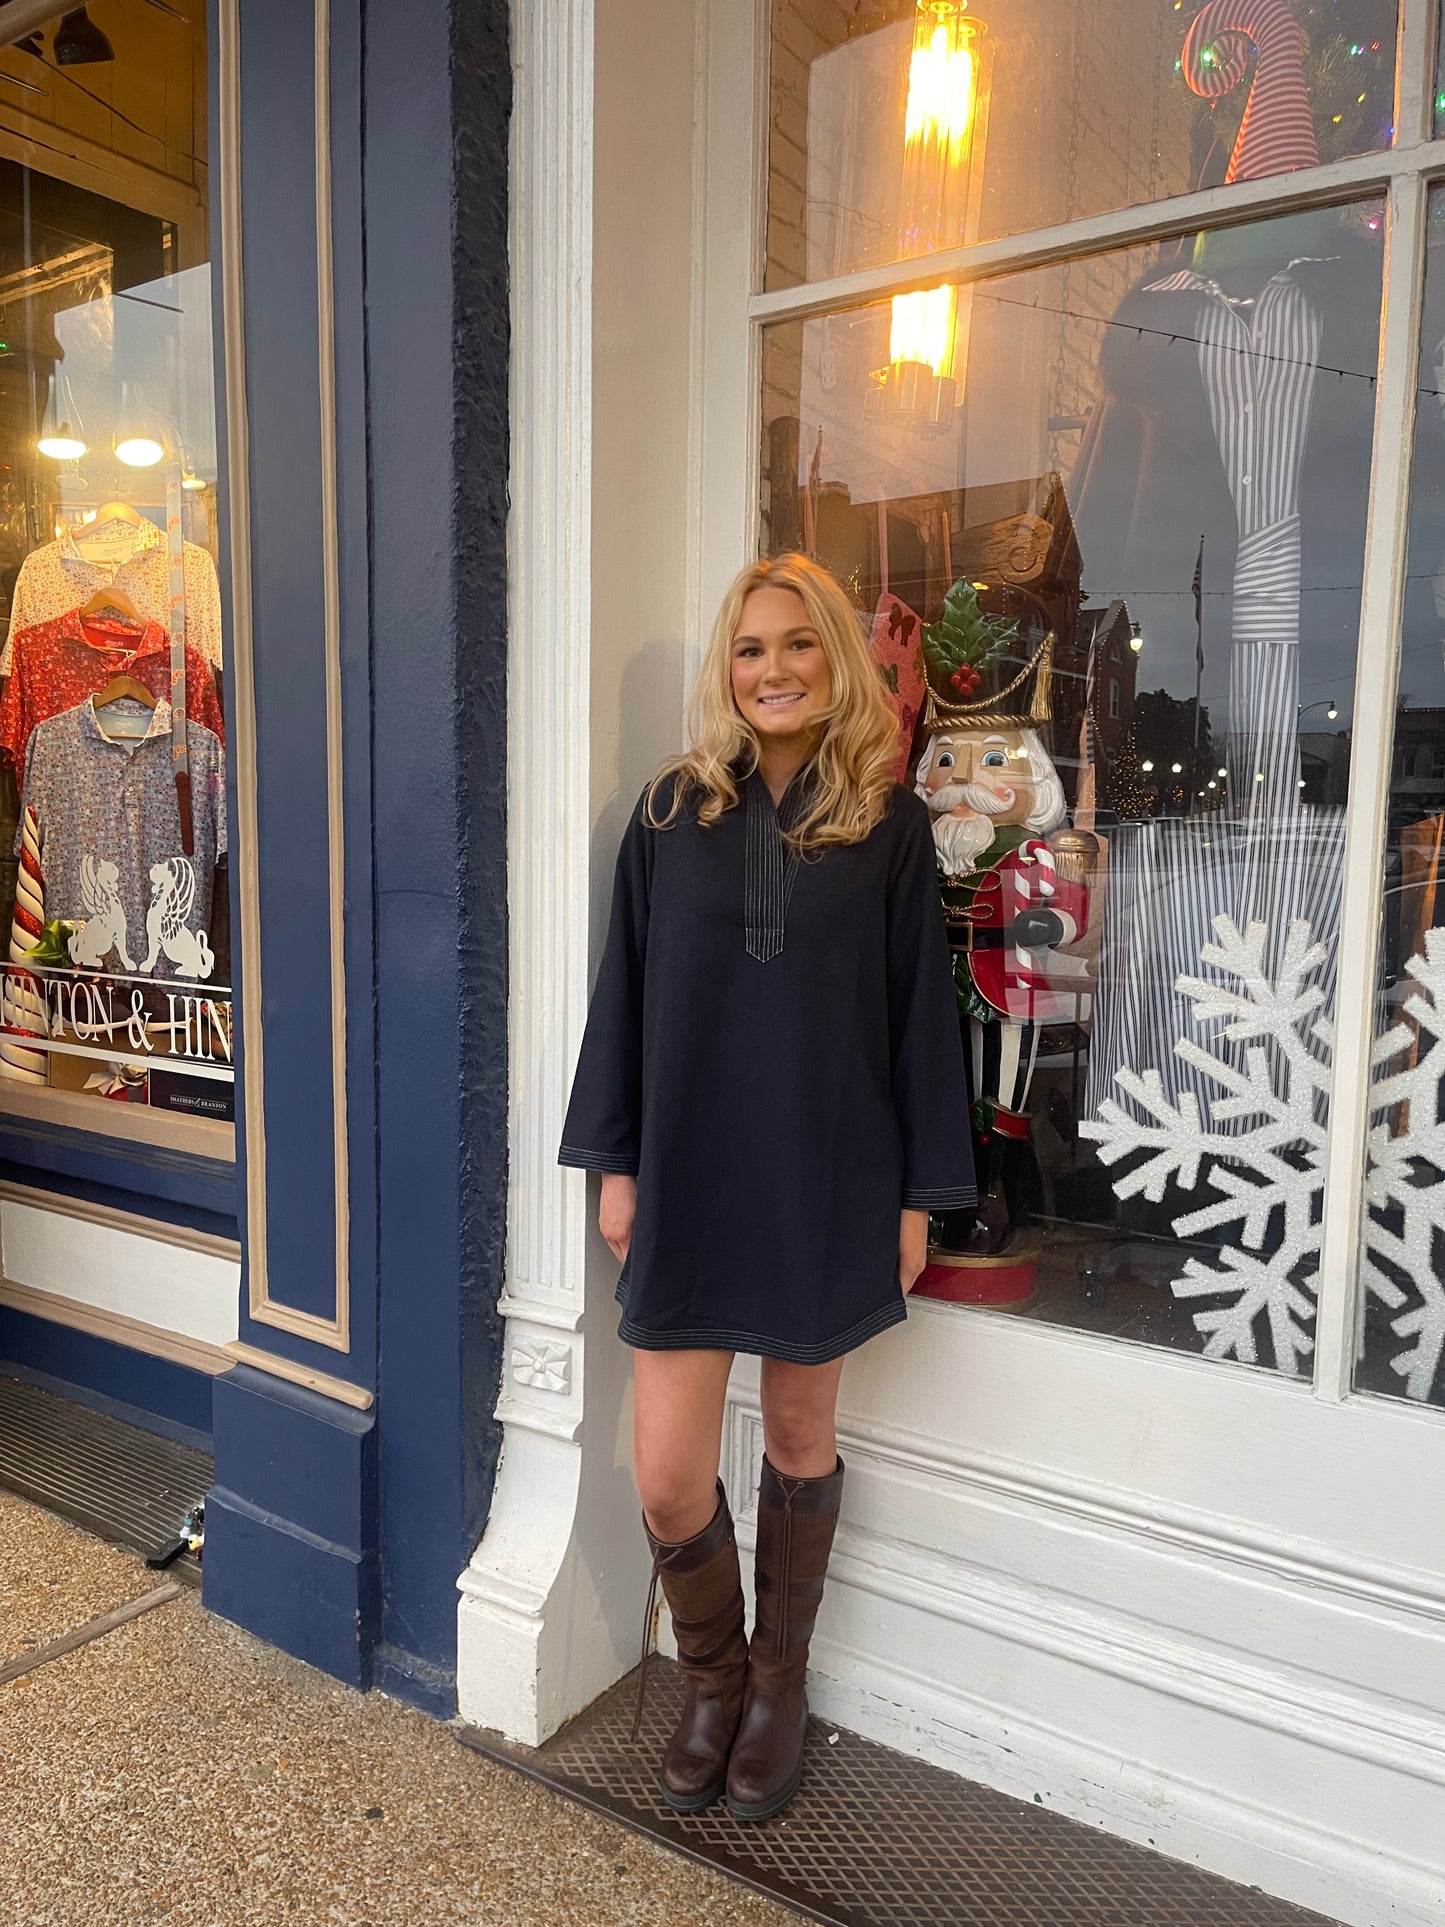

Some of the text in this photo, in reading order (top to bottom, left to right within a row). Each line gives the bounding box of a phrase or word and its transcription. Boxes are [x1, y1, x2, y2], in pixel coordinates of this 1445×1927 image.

[128, 989, 154, 1051] &
[166, 993, 232, 1063] HIN
[170, 1096, 195, 1105] SMATHERS
[201, 1101, 227, 1110] BRANSON
